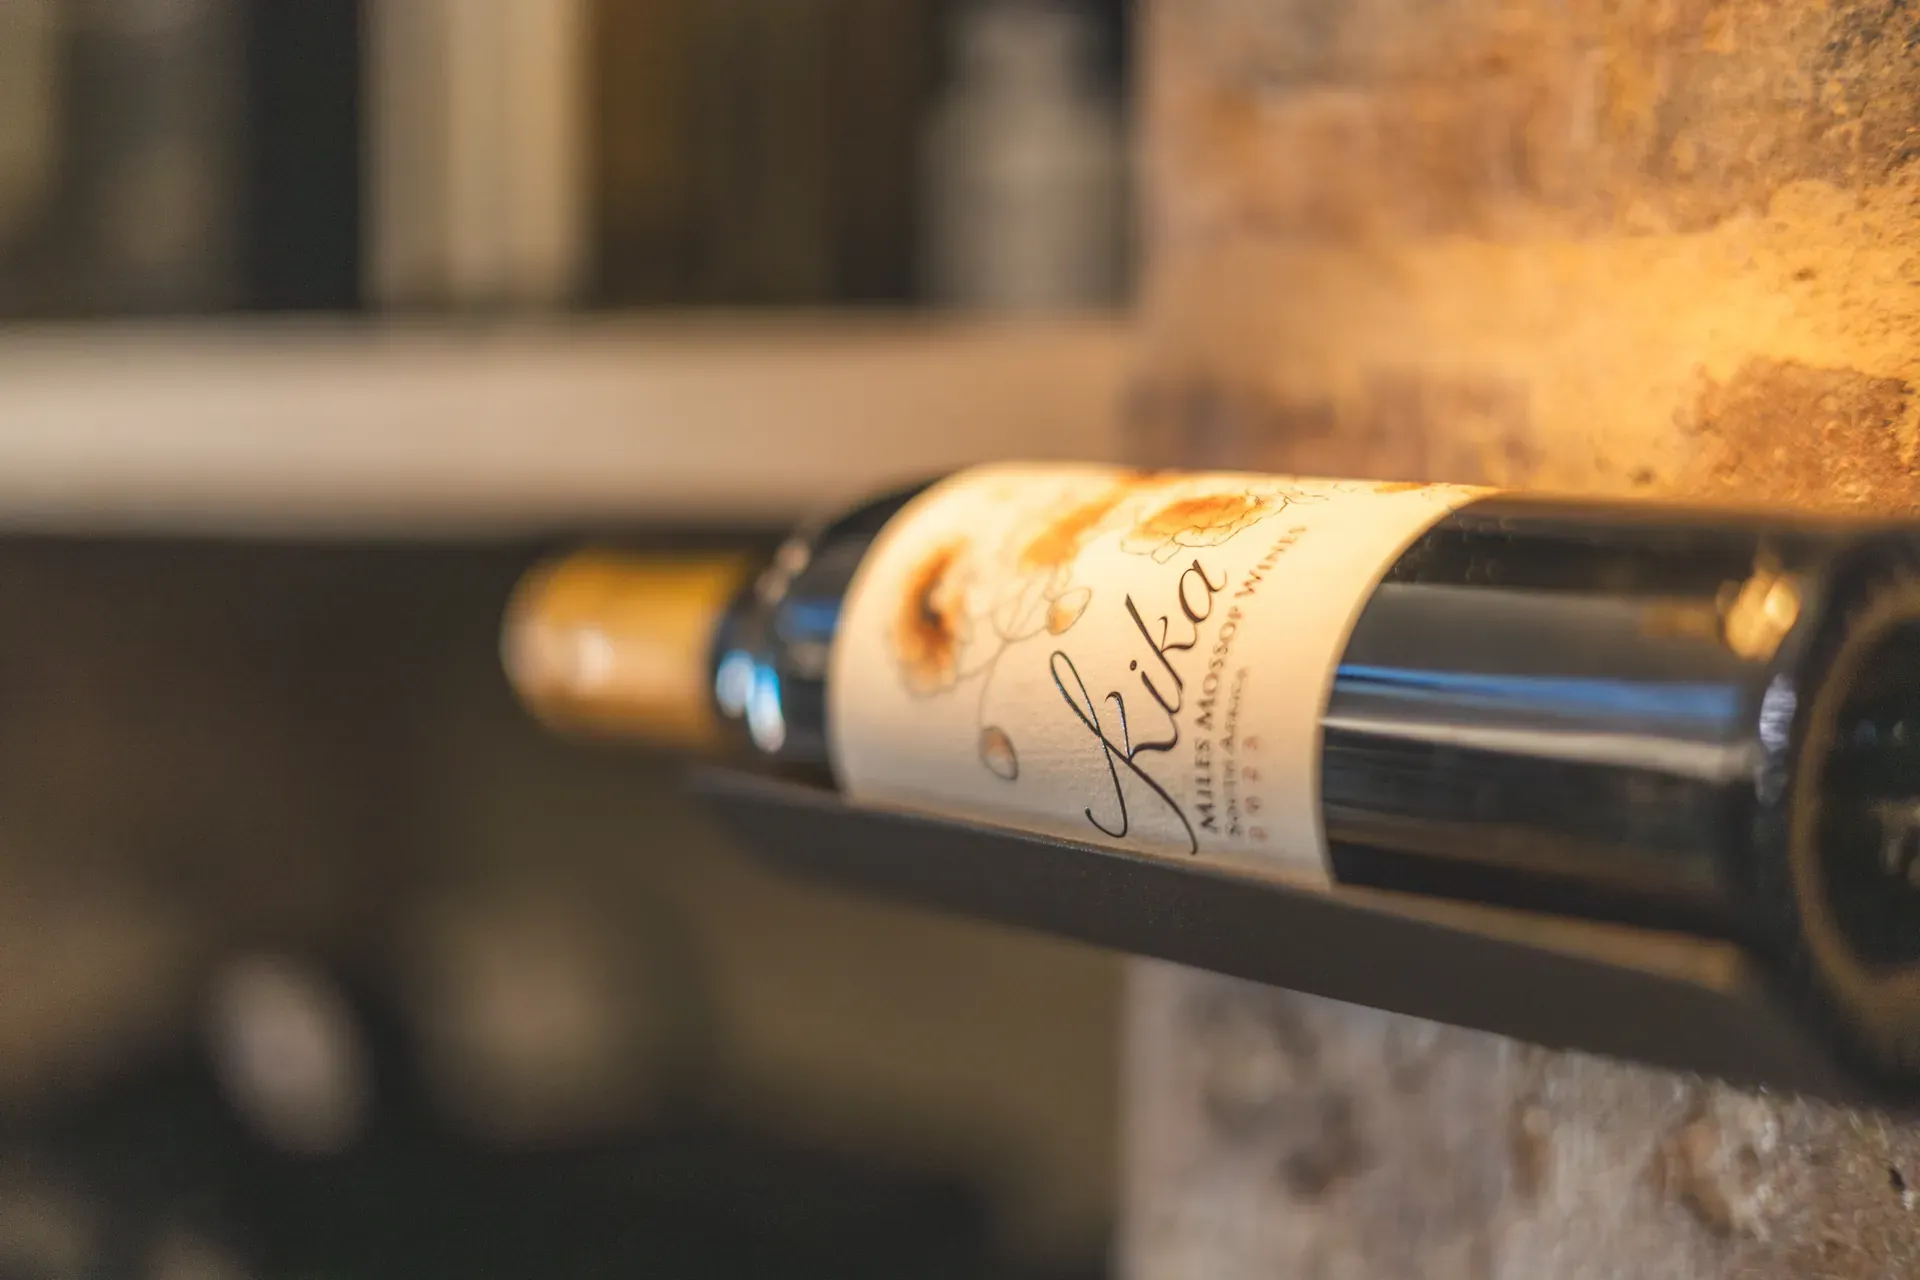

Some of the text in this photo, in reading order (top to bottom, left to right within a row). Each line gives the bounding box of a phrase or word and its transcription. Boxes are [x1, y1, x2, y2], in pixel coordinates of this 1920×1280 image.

[1049, 559, 1227, 855] Kika
[1193, 525, 1306, 834] MILES MOSSOP WINES
